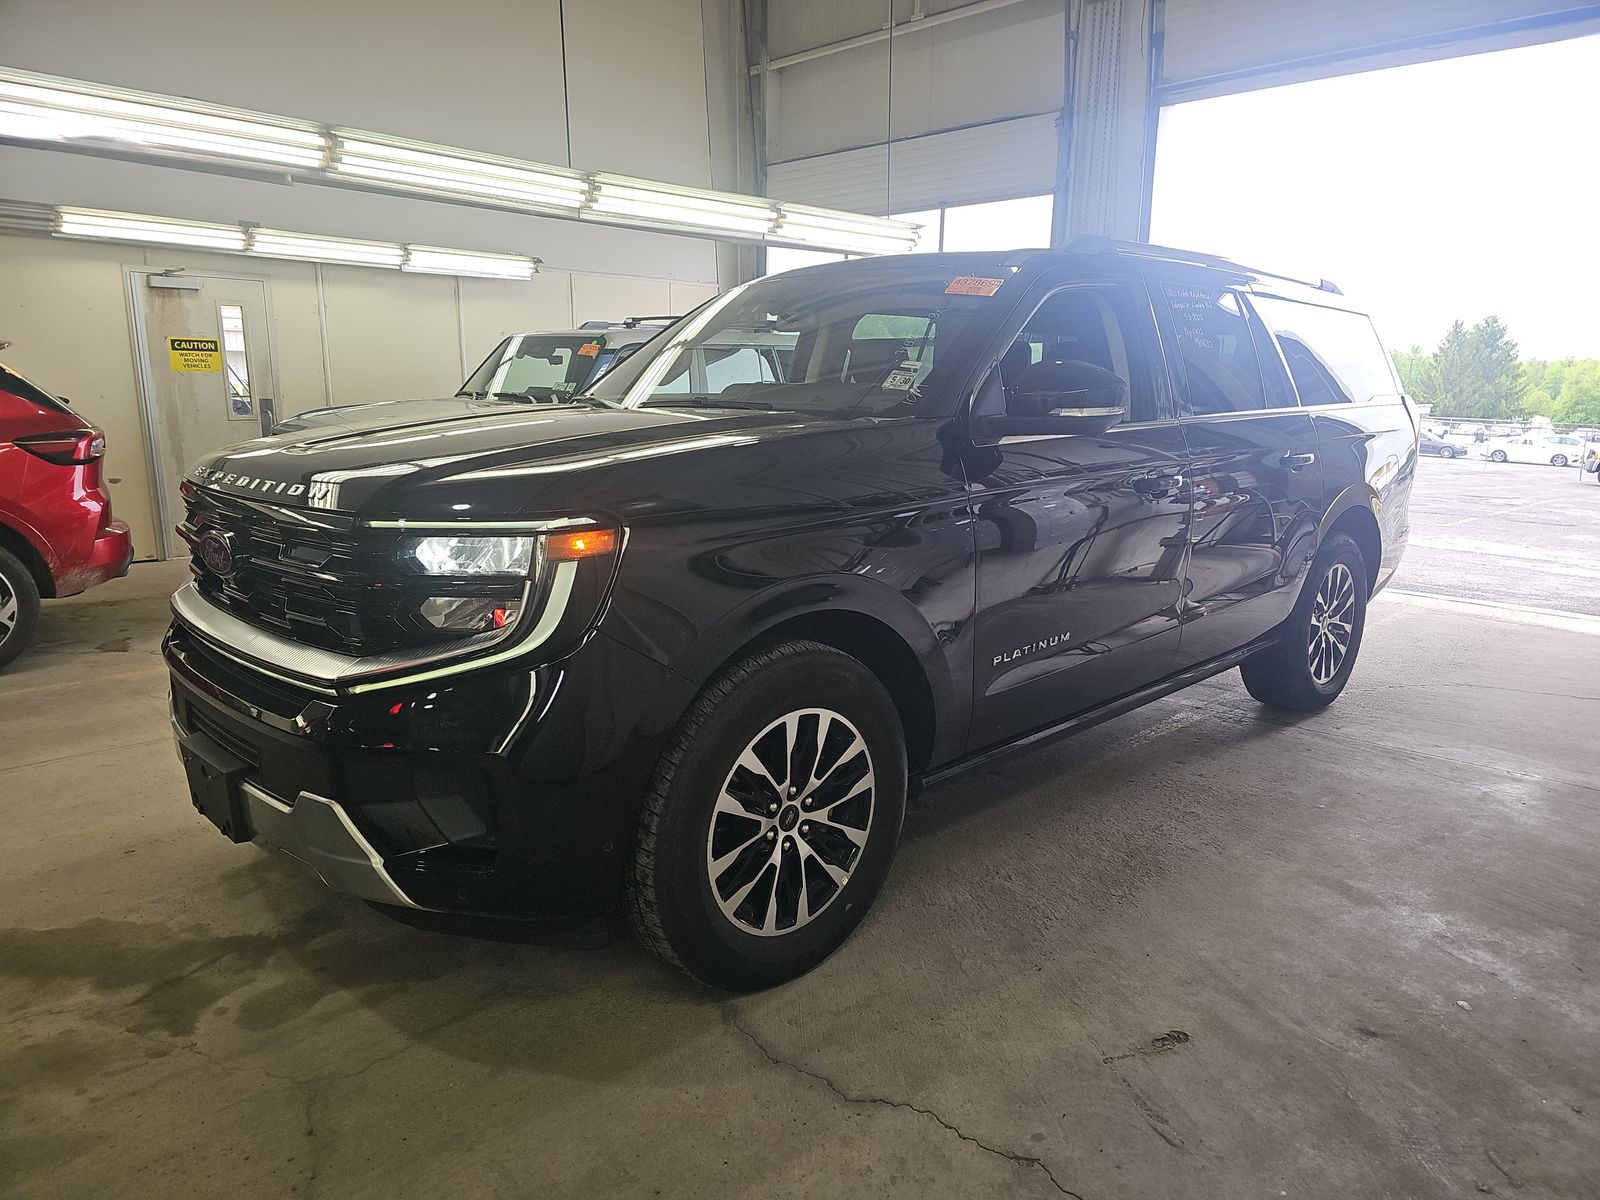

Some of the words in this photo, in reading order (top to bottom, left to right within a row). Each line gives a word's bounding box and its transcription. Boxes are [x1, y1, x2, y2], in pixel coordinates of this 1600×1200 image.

[174, 341, 215, 350] CAUTION
[899, 376, 911, 385] 30
[193, 465, 330, 501] EXPEDITION
[205, 537, 227, 570] Ford
[992, 631, 1071, 667] PLATINUM
